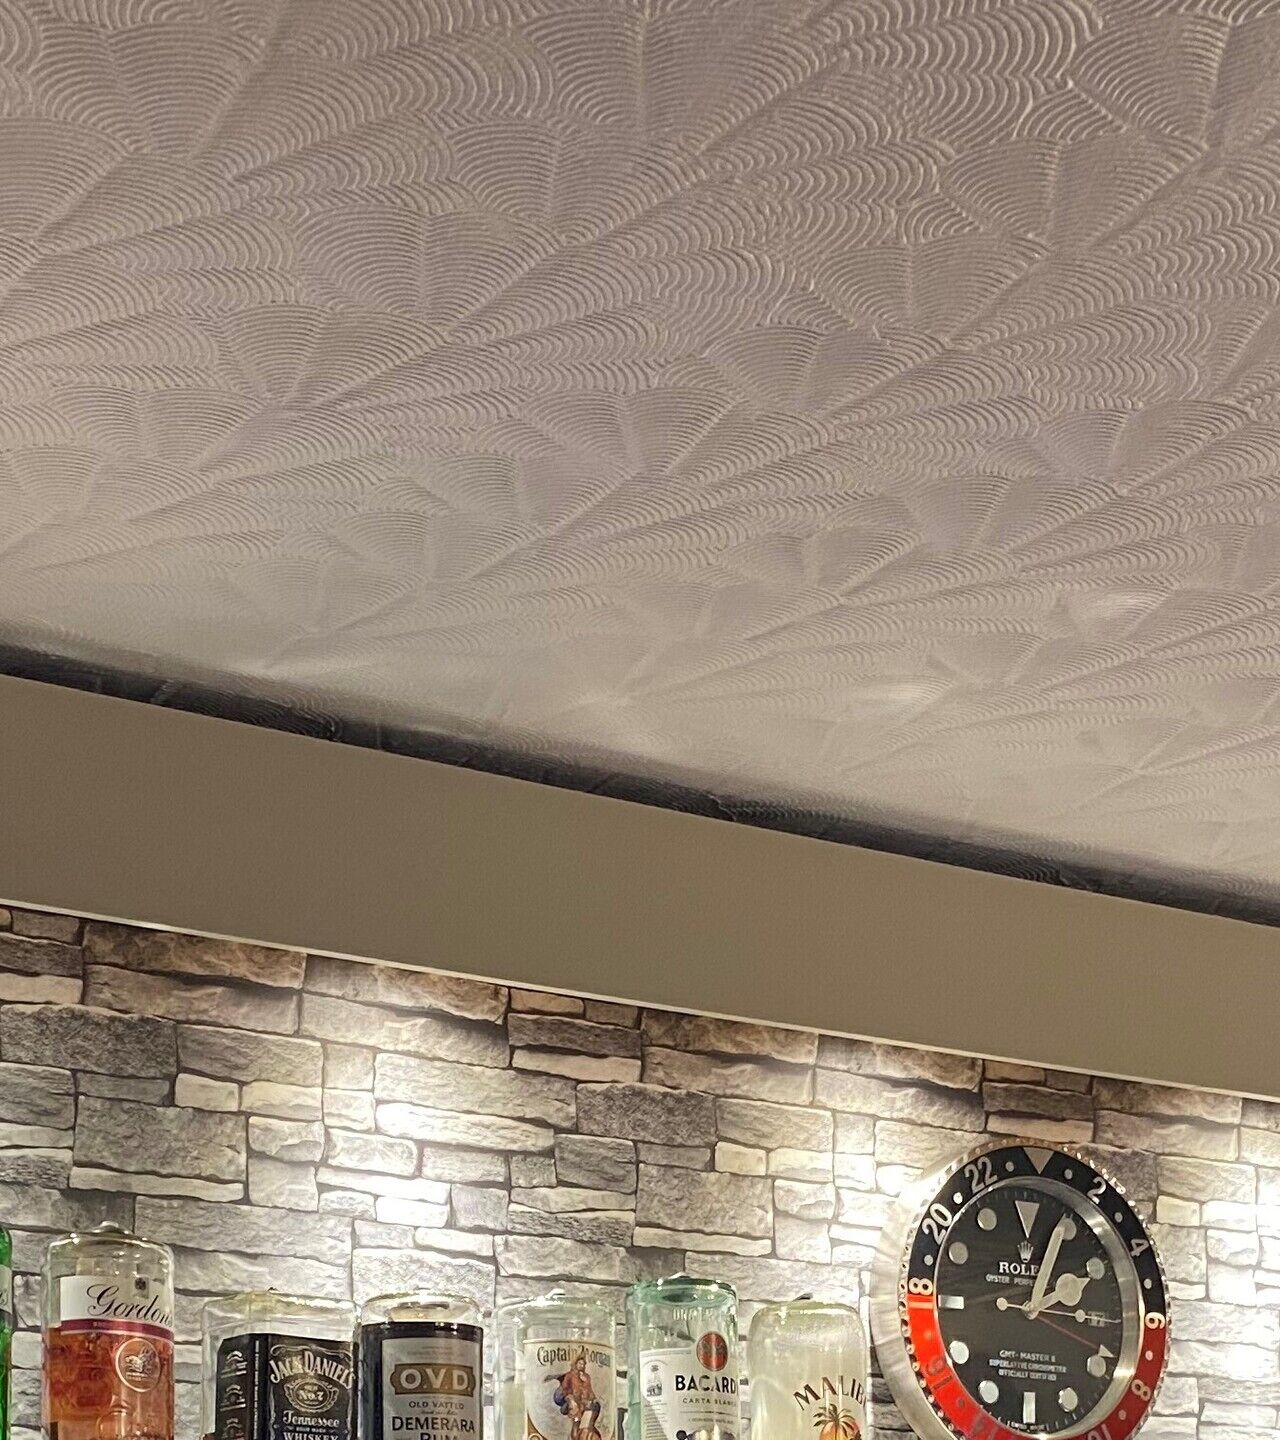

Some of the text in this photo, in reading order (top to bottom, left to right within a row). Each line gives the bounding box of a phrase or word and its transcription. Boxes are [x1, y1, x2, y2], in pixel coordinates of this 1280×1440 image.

[965, 1156, 998, 1193] 22
[1088, 1176, 1107, 1205] 2
[921, 1202, 953, 1245] 20
[1131, 1238, 1150, 1258] 4
[999, 1261, 1039, 1276] ROLE
[1144, 1311, 1166, 1331] 6
[268, 1356, 304, 1384] JACK
[1131, 1379, 1151, 1401] 8
[408, 1401, 429, 1409] OLD
[682, 1397, 711, 1405] CARTA
[282, 1409, 340, 1428] Tennessee
[391, 1416, 475, 1434] DEMERARA
